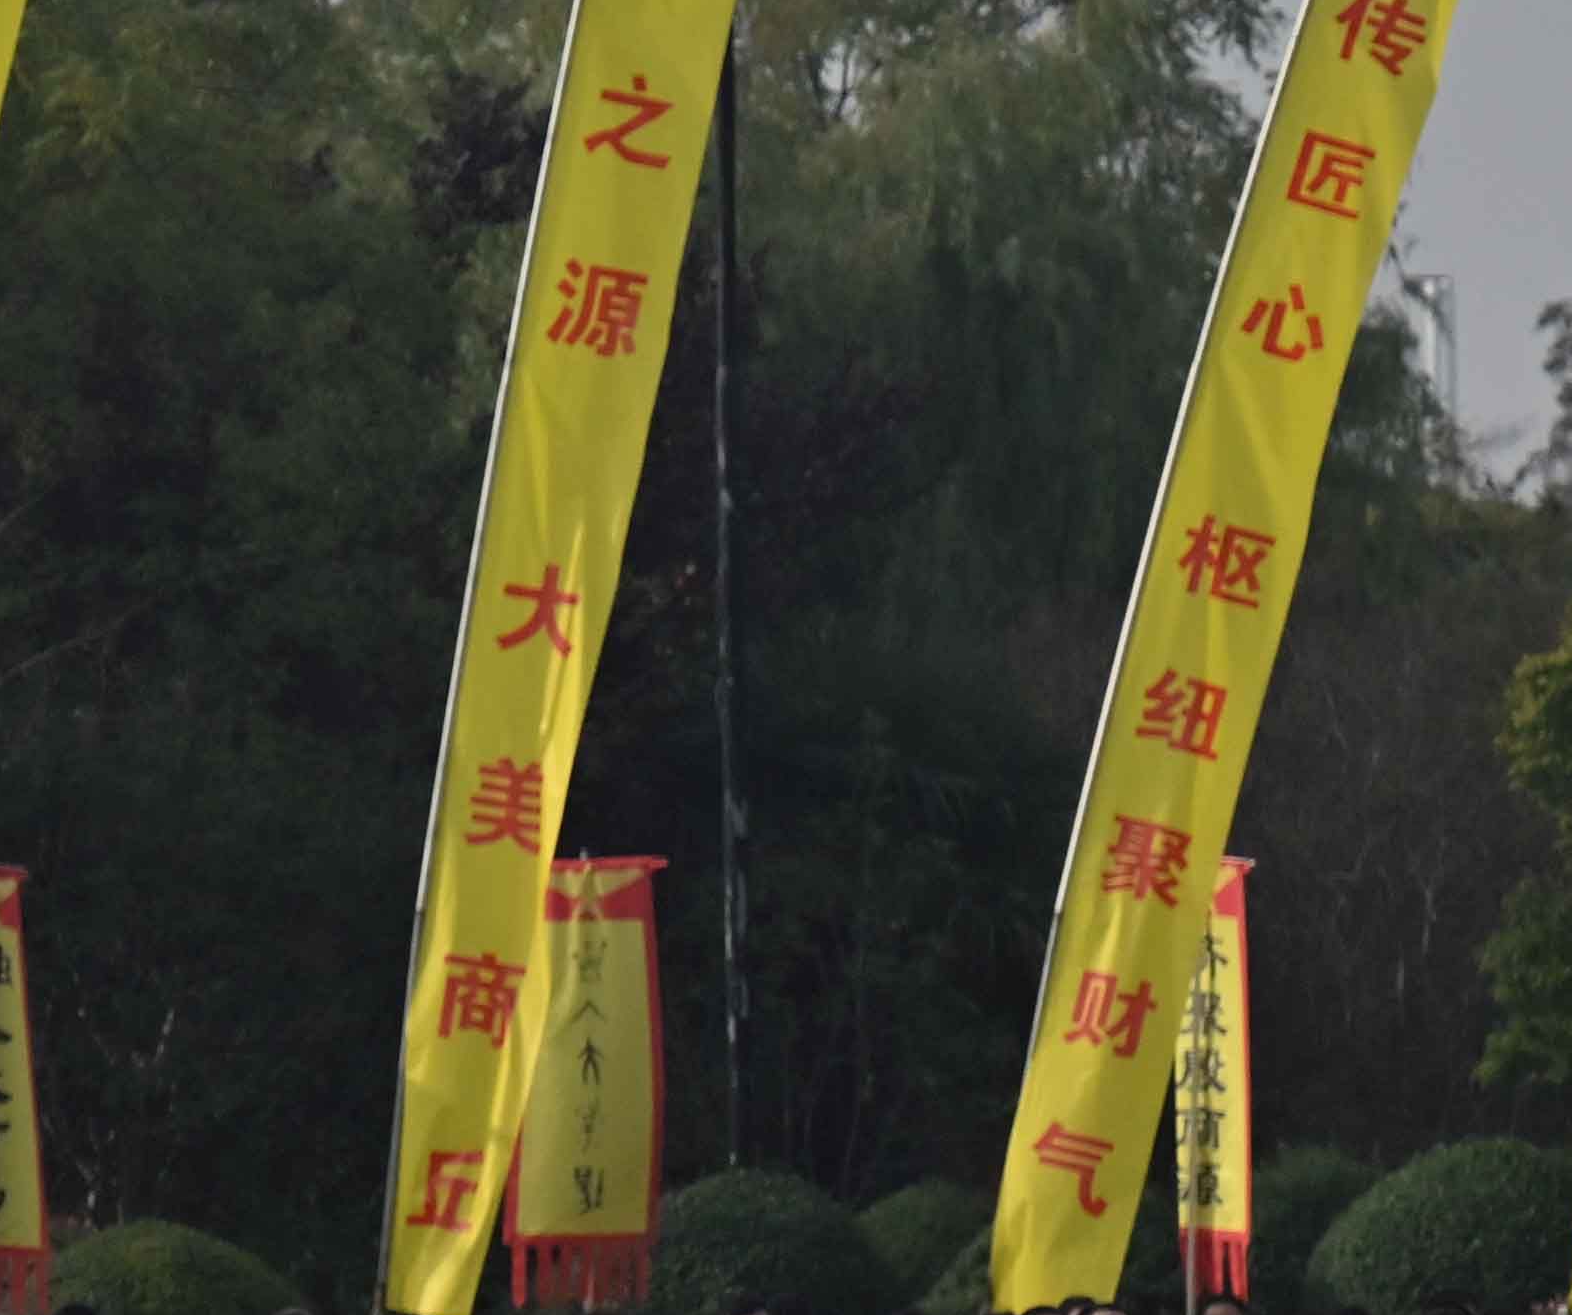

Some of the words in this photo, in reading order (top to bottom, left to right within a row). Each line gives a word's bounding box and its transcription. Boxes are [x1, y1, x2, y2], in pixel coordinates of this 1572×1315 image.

[408, 565, 580, 1233] 大美商丘
[1034, 515, 1275, 1220] 枢纽聚财气
